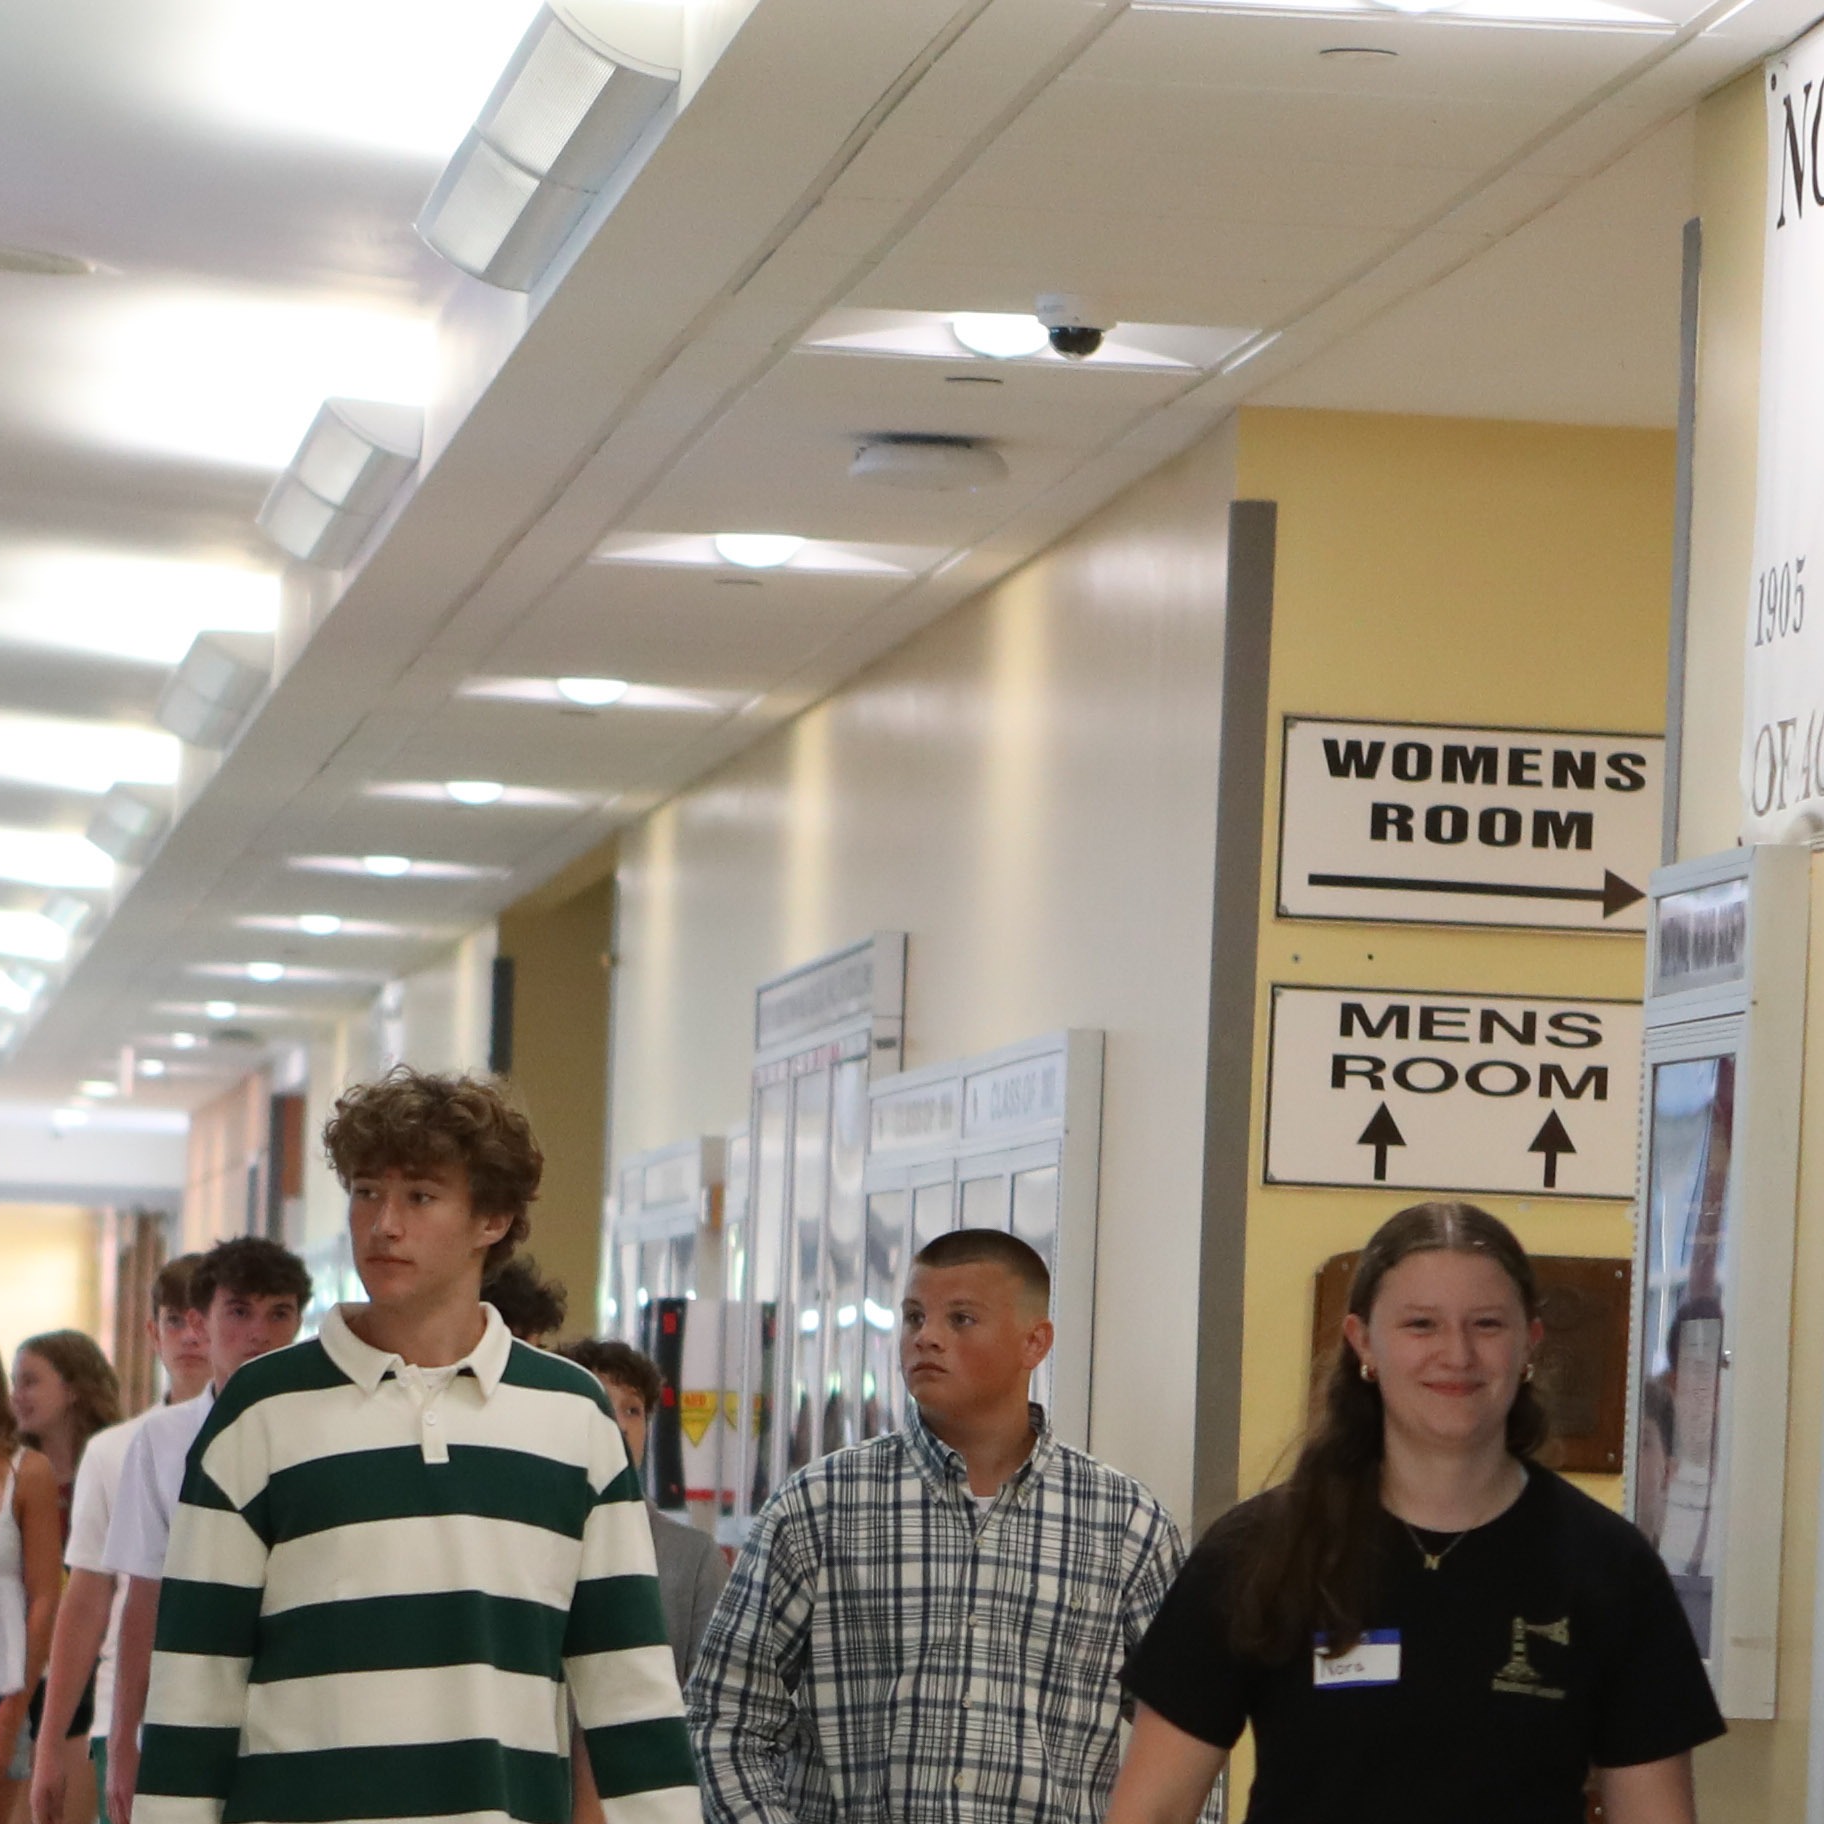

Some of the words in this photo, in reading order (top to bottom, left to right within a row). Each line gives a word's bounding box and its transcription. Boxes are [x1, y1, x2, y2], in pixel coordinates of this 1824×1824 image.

[1756, 554, 1806, 648] 1905
[1322, 738, 1647, 793] WOMENS
[1751, 716, 1798, 819] OF
[1369, 801, 1594, 851] ROOM
[1338, 1001, 1604, 1049] MENS
[1330, 1053, 1609, 1102] ROOM
